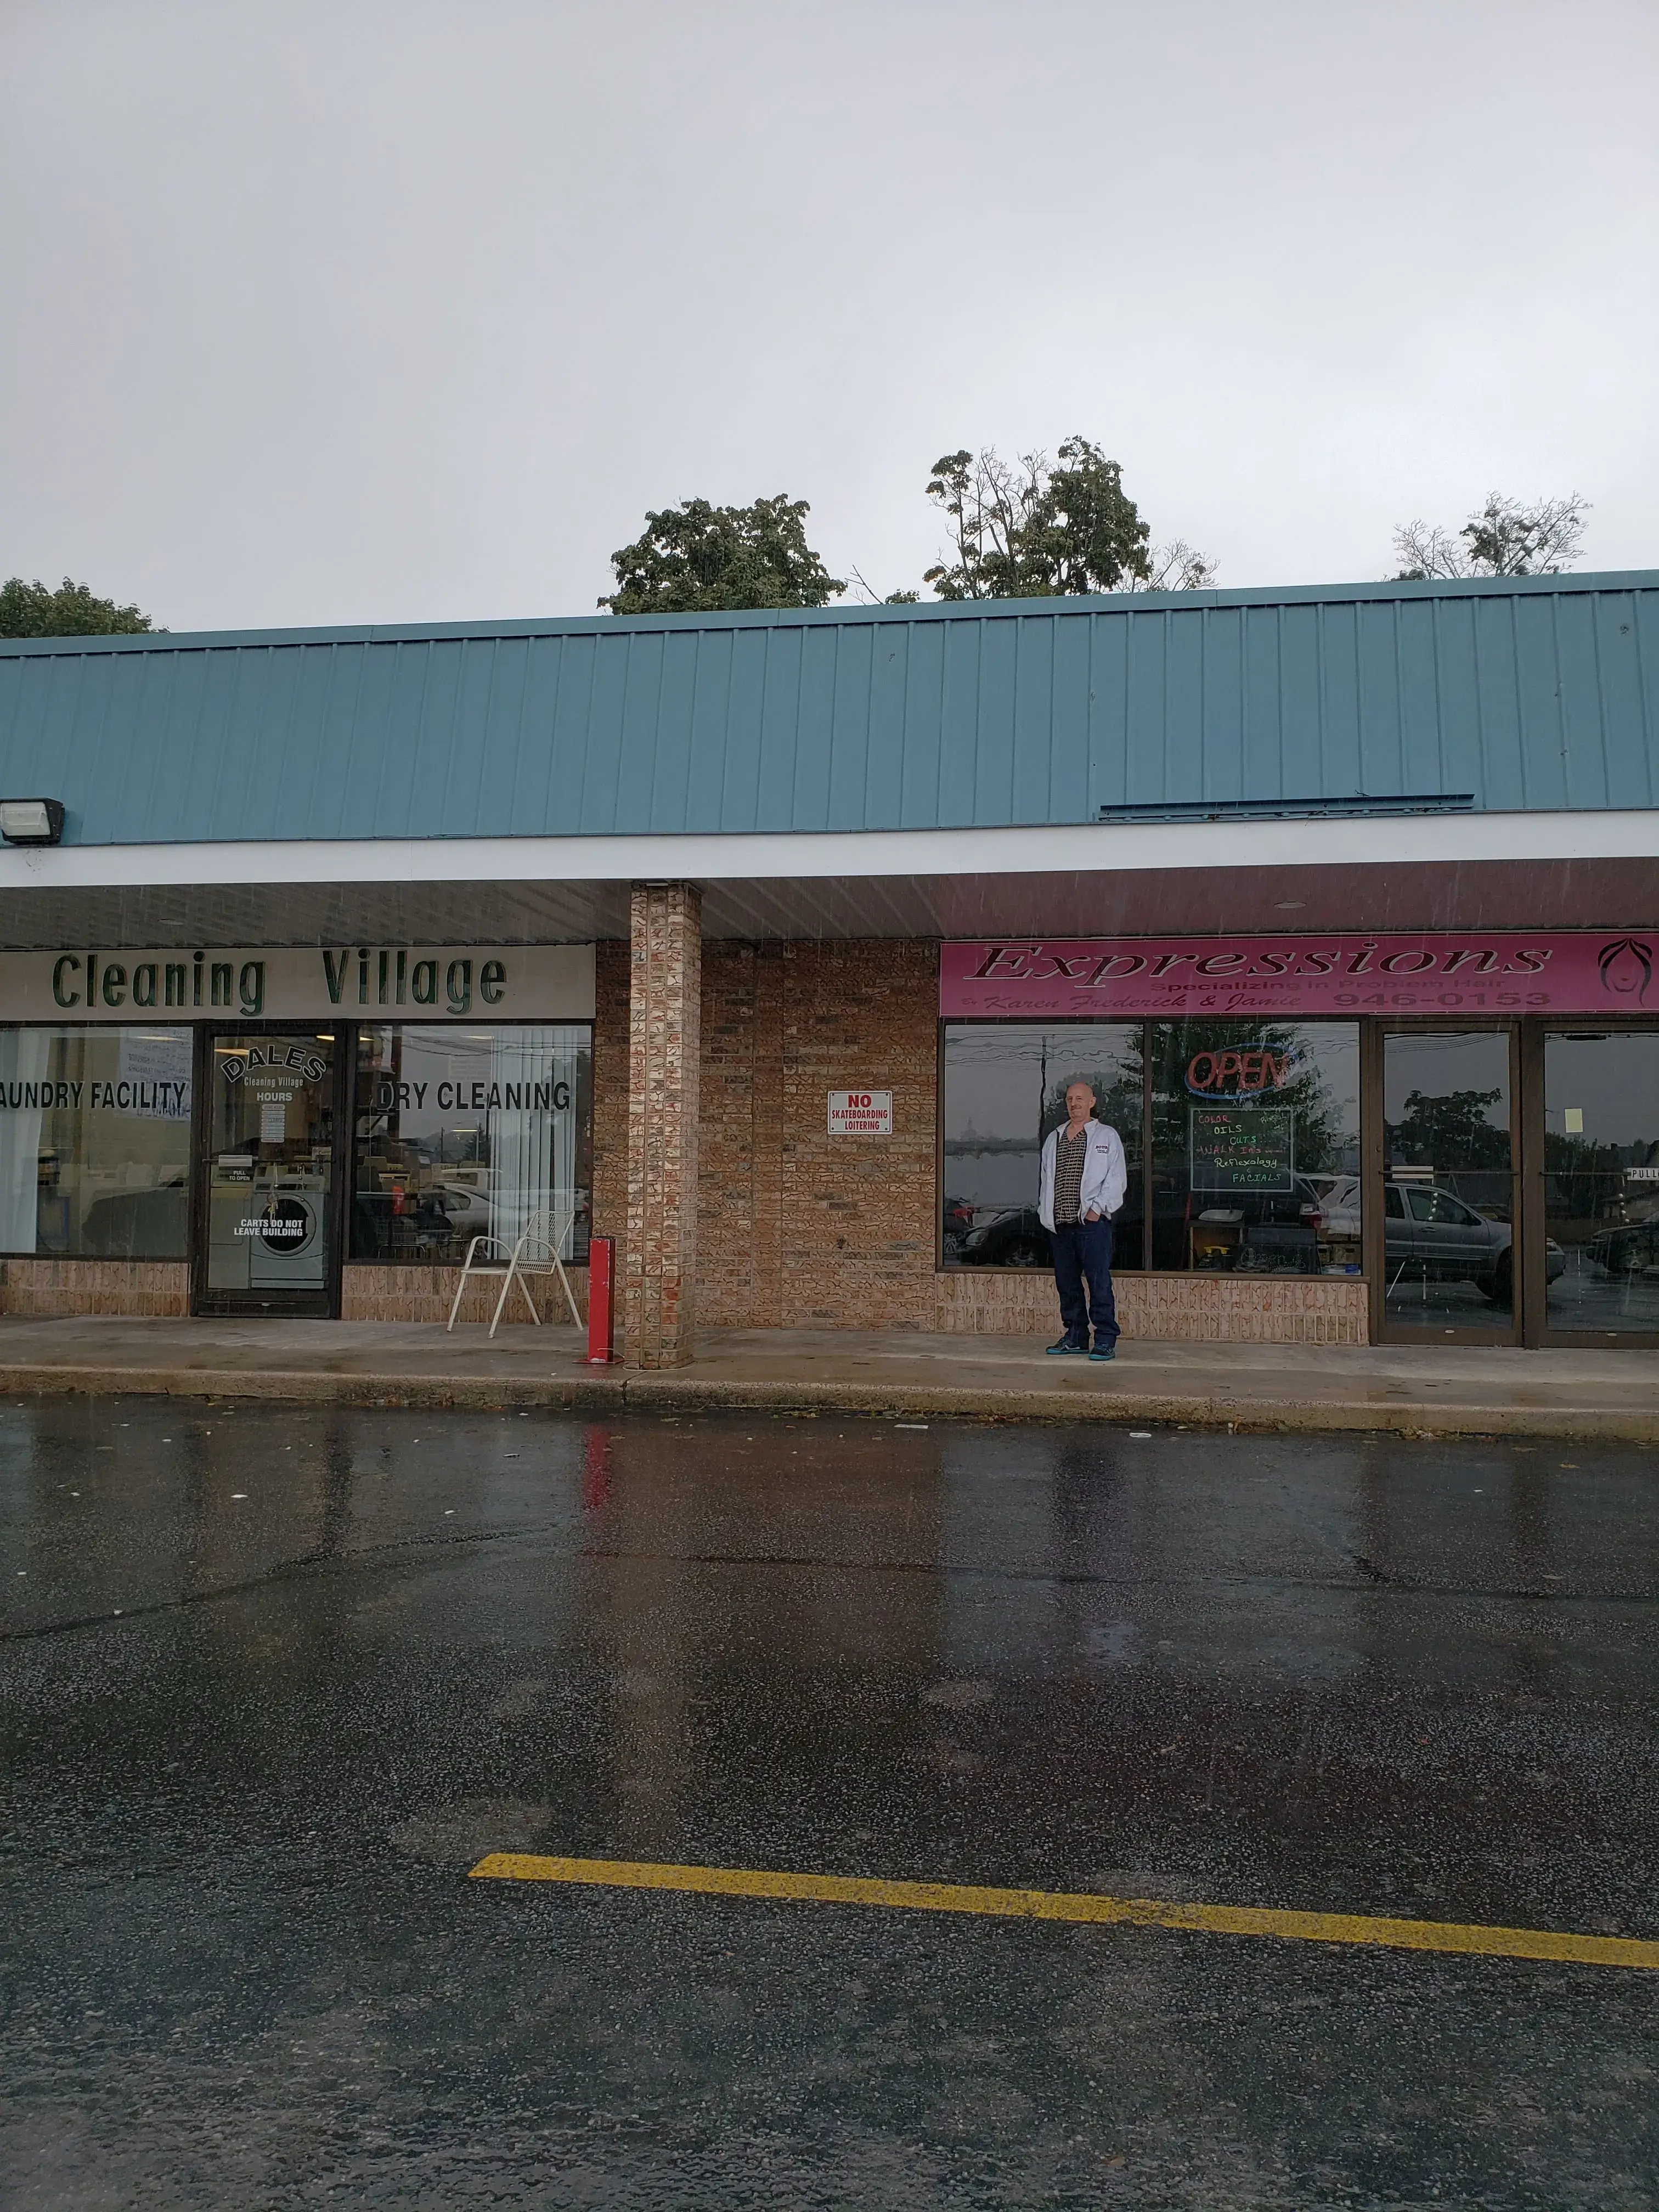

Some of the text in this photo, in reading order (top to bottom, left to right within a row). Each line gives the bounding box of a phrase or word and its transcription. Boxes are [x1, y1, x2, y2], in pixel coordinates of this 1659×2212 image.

[963, 942, 1553, 988] Expressions
[53, 948, 506, 1016] Cleaning Village
[1150, 979, 1506, 991] Specializing in Problem Hair
[984, 996, 1060, 1009] Karen
[1068, 994, 1187, 1009] Frederick
[1199, 995, 1215, 1006] &
[1224, 993, 1301, 1011] Jamie
[1333, 992, 1551, 1007] 946-0153
[221, 1045, 326, 1083] DALES
[1188, 1052, 1289, 1089] OPEN
[244, 1076, 303, 1088] Cleaning Village
[91, 1081, 187, 1109] FACILITY
[256, 1092, 293, 1102] HOURS
[376, 1081, 571, 1110] DRY CLEANING
[848, 1094, 872, 1108] NO
[832, 1110, 888, 1119] SKATEBOARDING
[1198, 1115, 1232, 1124] COLOR
[845, 1121, 880, 1130] LOITERING
[1214, 1125, 1242, 1135] OILS
[1230, 1136, 1257, 1146] CUTS
[1214, 1156, 1277, 1168] Reflexology
[1233, 1173, 1282, 1183] FACIALS
[1632, 1170, 1657, 1178] PULL
[241, 1219, 303, 1228] CARTS DO NOT
[262, 1228, 303, 1236] BUILDING
